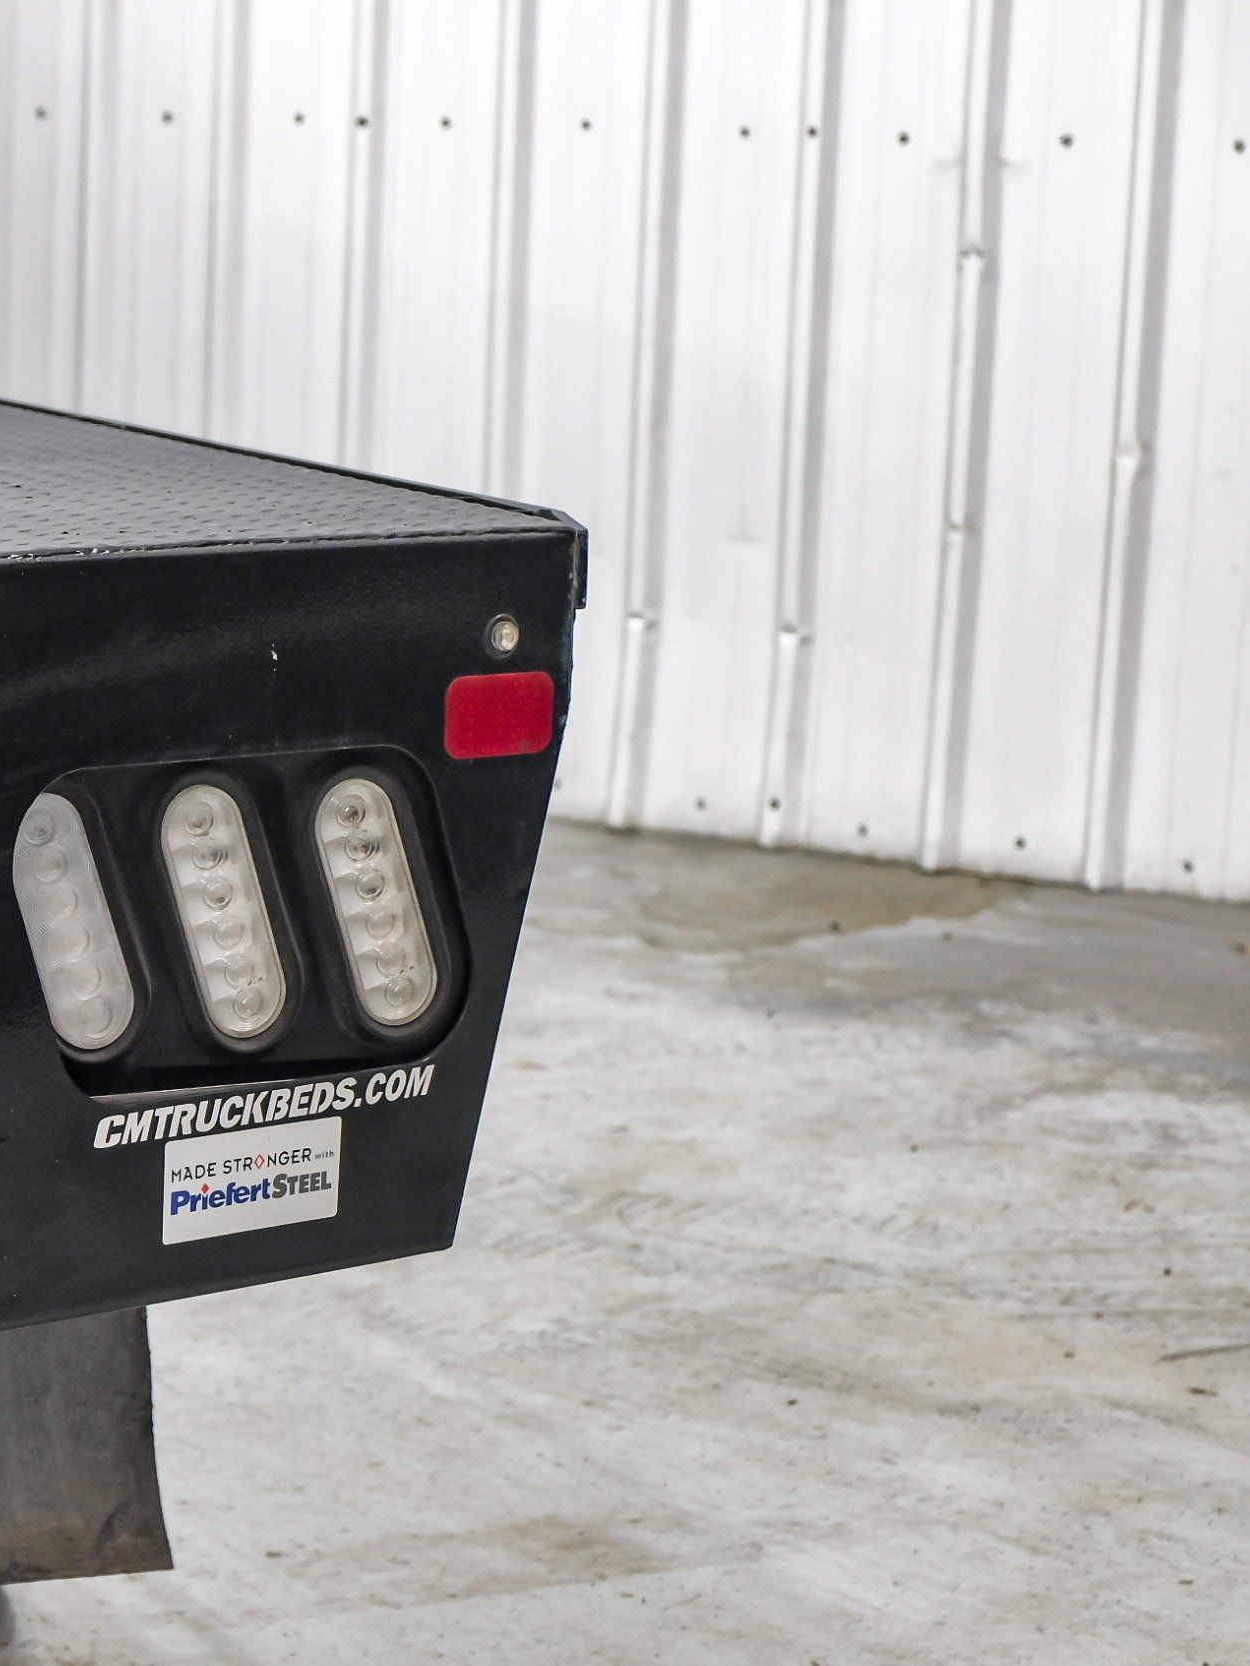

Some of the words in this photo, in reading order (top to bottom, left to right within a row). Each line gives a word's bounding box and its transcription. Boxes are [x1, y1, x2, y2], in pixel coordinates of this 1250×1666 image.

[93, 1064, 435, 1149] CMTRUCKBEDS.COM
[171, 1162, 217, 1183] MADE
[314, 1150, 334, 1160] with
